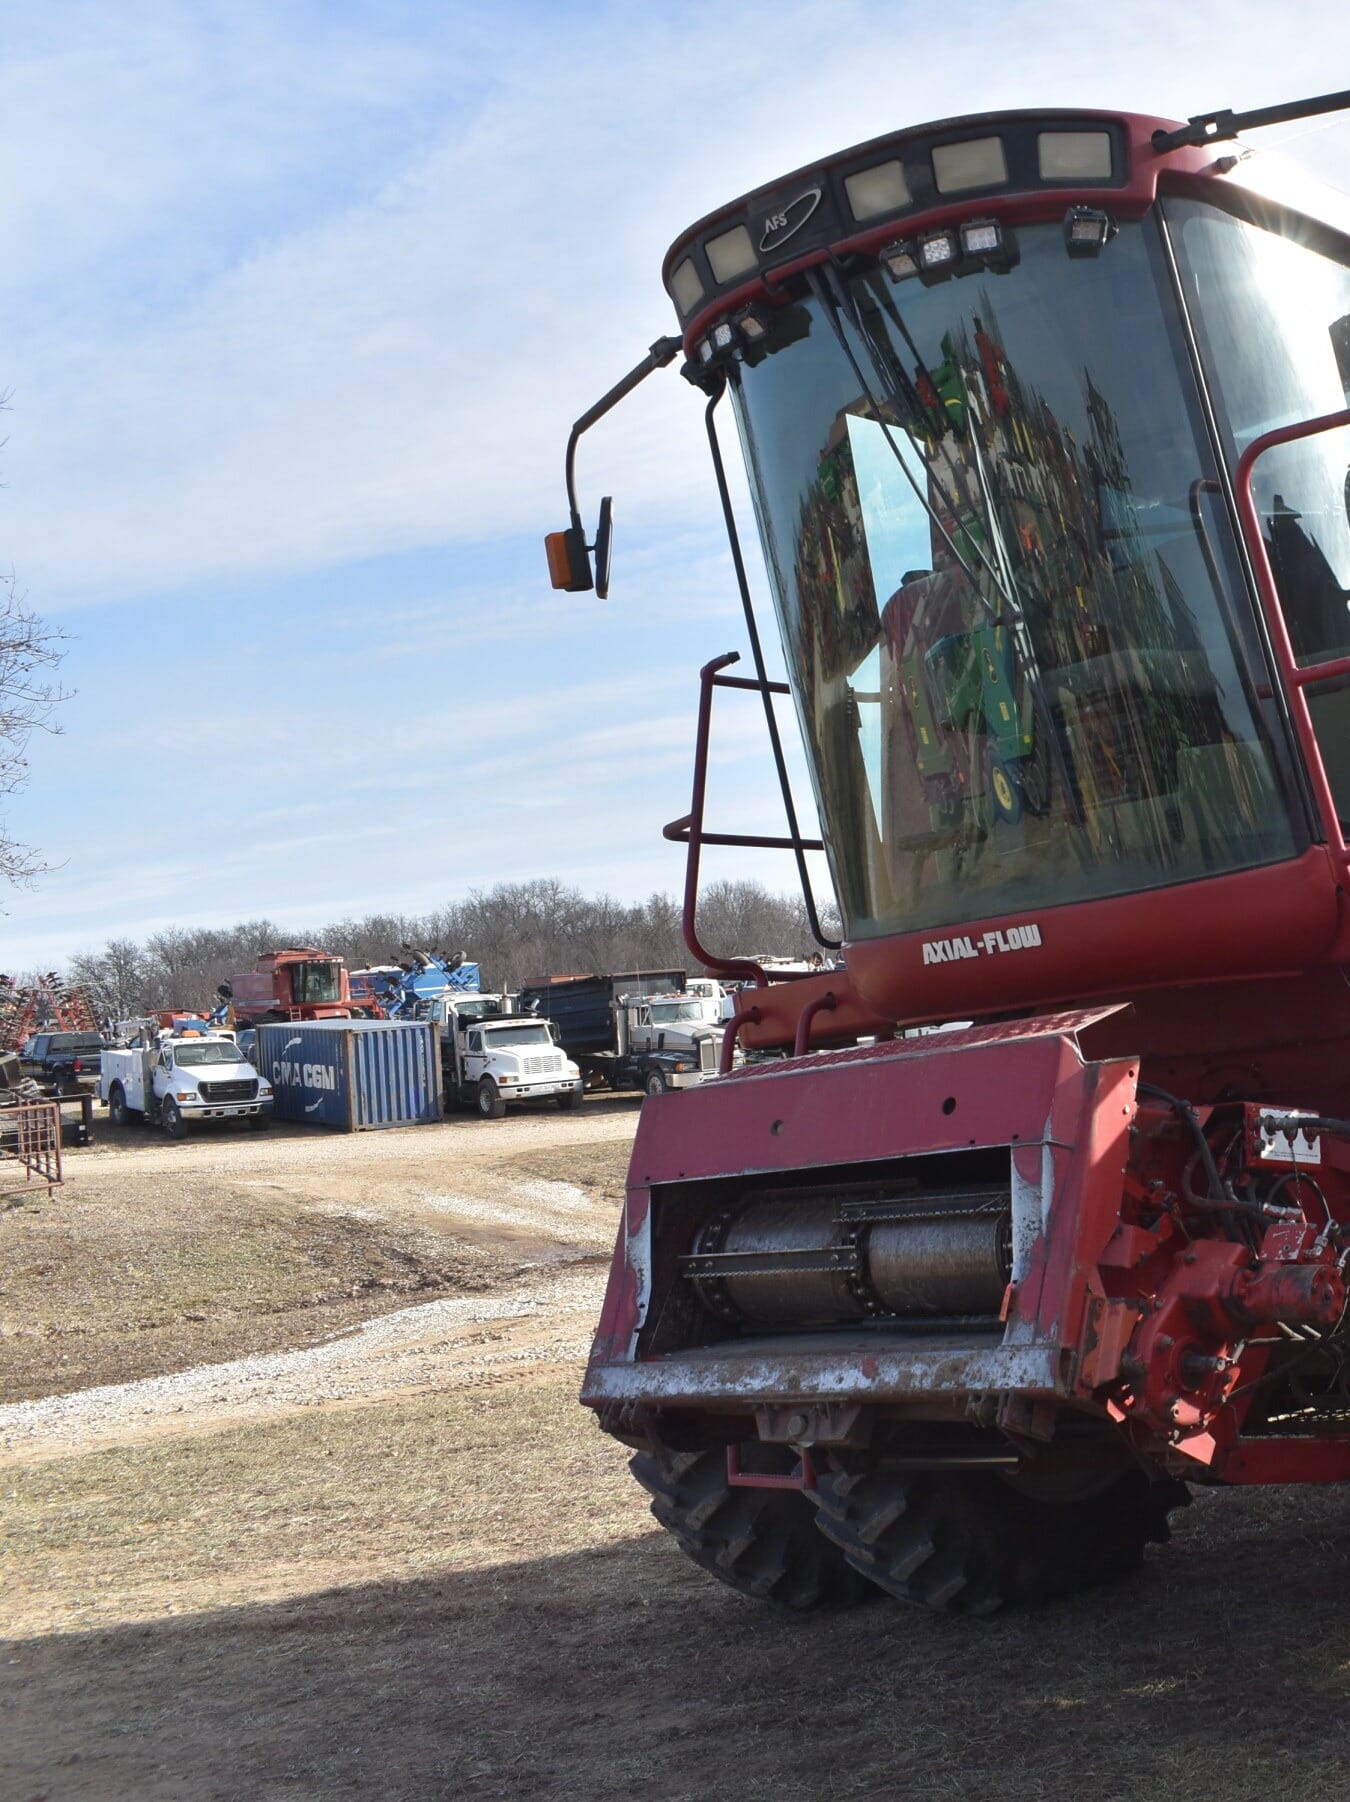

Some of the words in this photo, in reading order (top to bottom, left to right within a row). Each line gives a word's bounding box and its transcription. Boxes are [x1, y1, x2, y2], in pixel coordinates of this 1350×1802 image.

[765, 212, 788, 233] AFS
[922, 924, 1042, 965] AXIAL-FLOW
[272, 1061, 303, 1088] CMA
[303, 1063, 336, 1091] CGM
